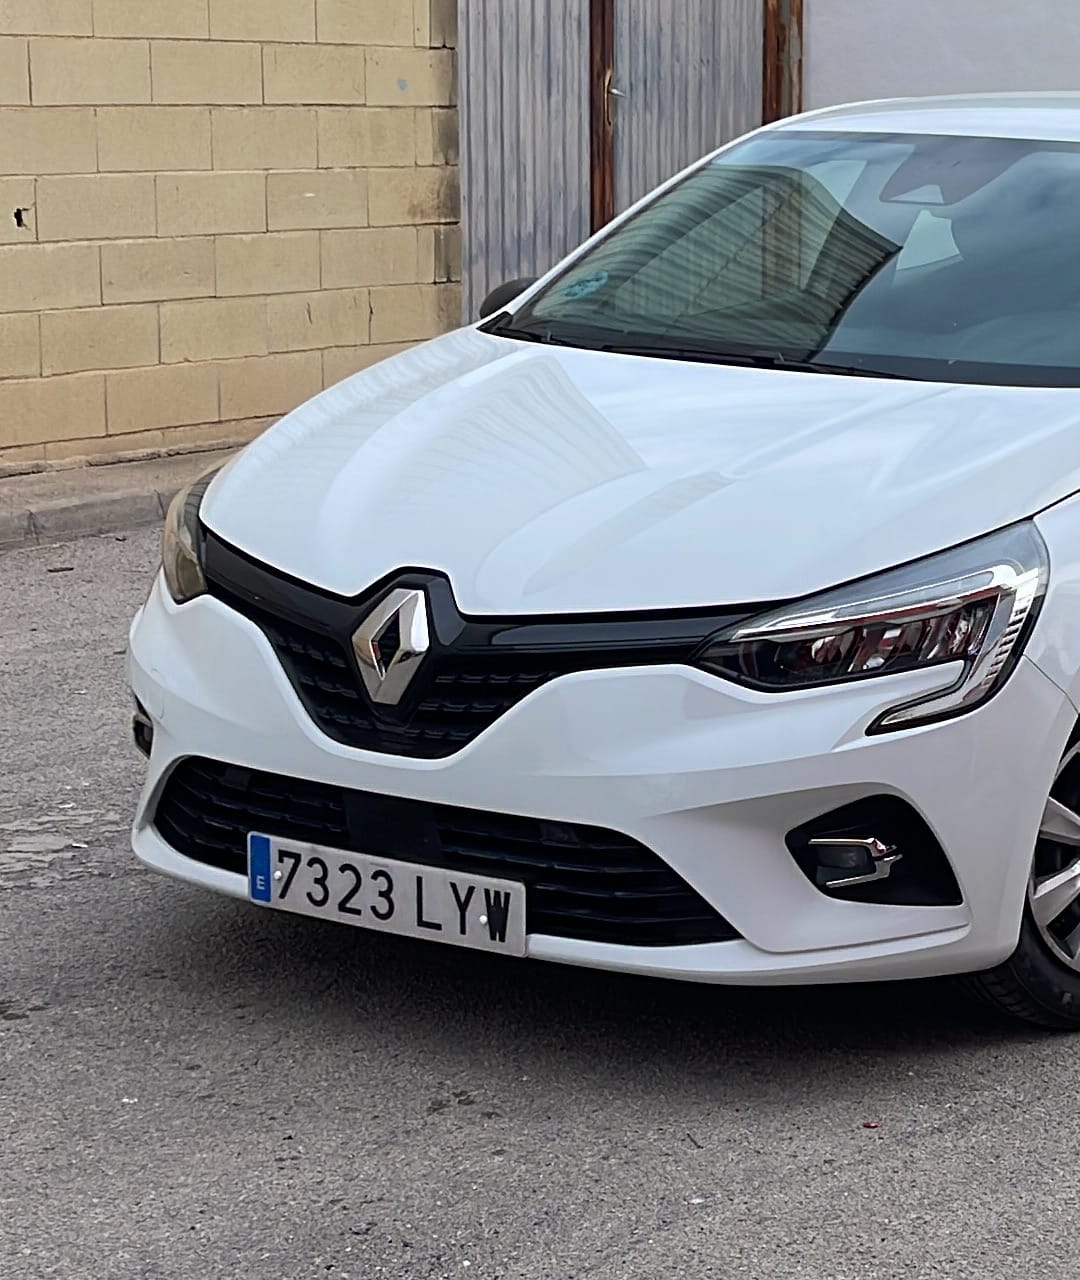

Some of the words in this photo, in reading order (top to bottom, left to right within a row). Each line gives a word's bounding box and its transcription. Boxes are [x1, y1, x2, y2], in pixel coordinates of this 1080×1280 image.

[256, 876, 265, 890] E
[276, 849, 395, 920] 7323
[416, 875, 511, 942] LYW
